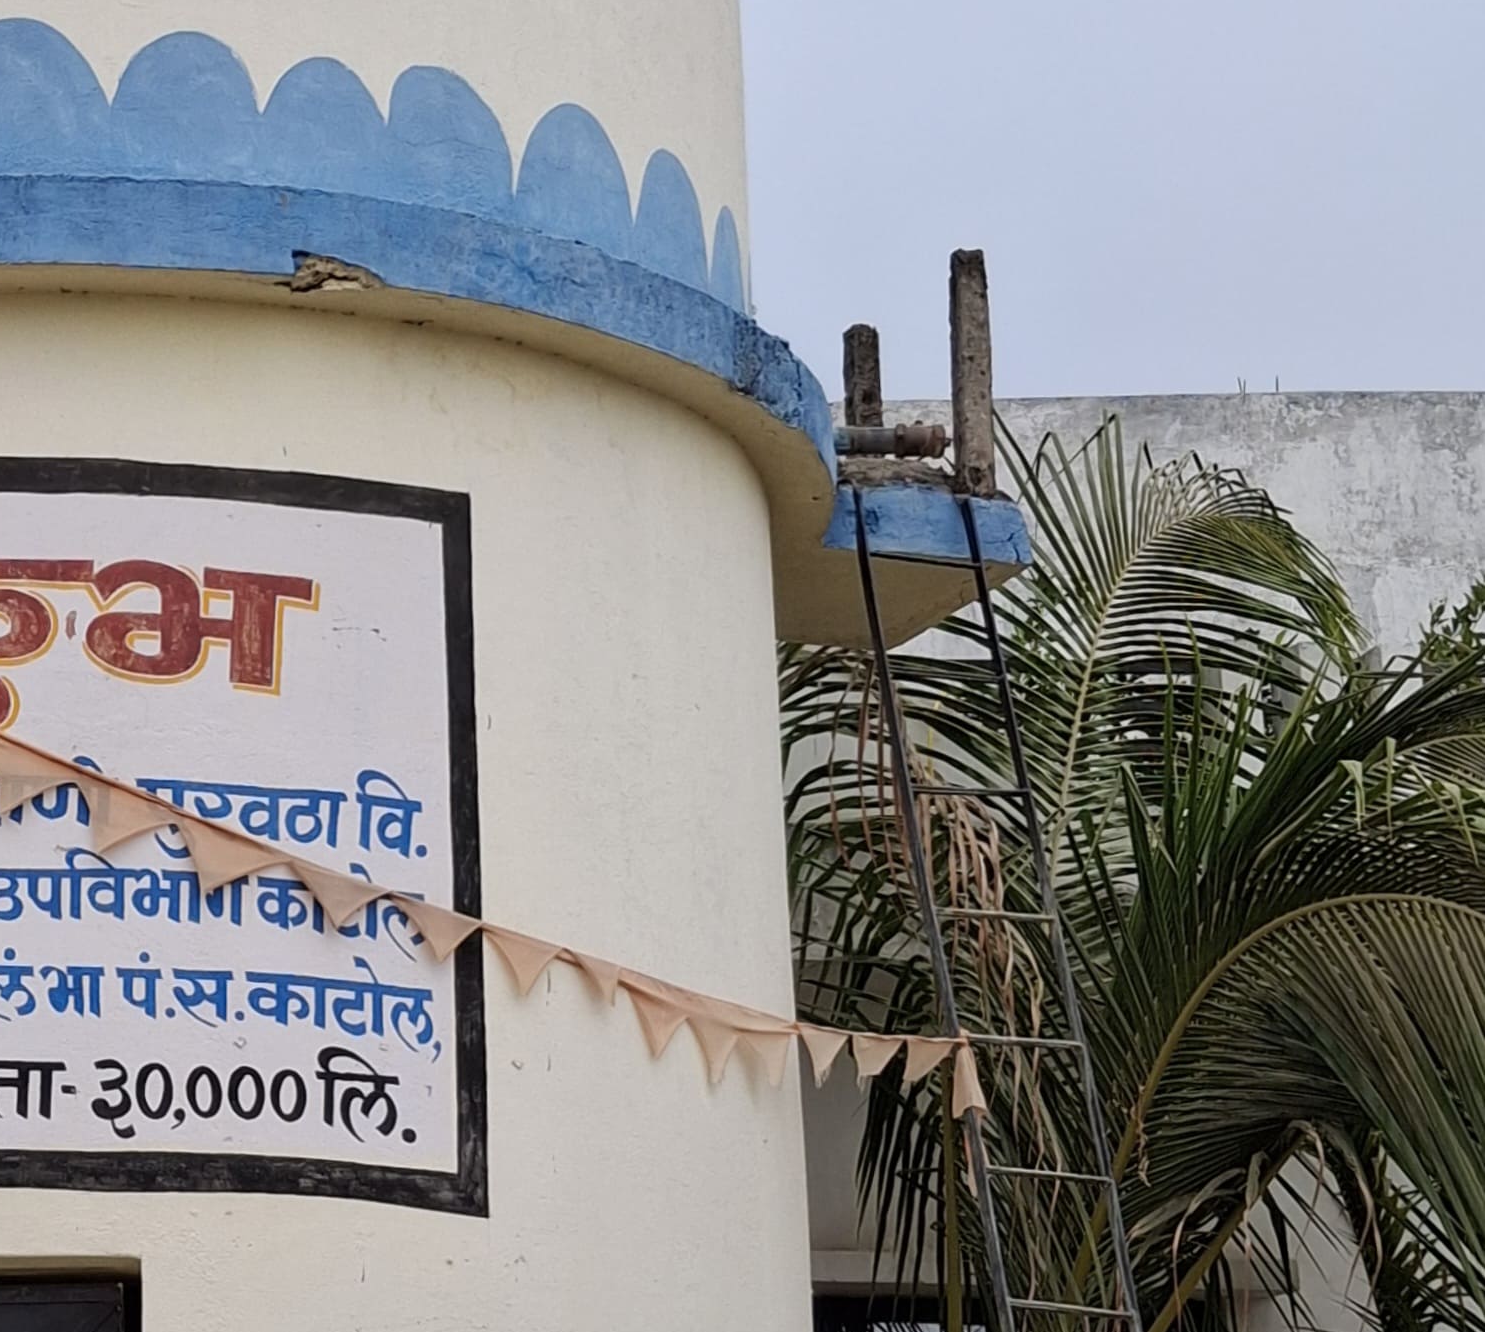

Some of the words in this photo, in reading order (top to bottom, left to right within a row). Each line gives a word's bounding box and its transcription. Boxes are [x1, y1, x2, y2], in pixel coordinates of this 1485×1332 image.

[355, 769, 428, 858] वि.
[257, 863, 426, 962] काोल
[315, 1046, 418, 1144] लि.
